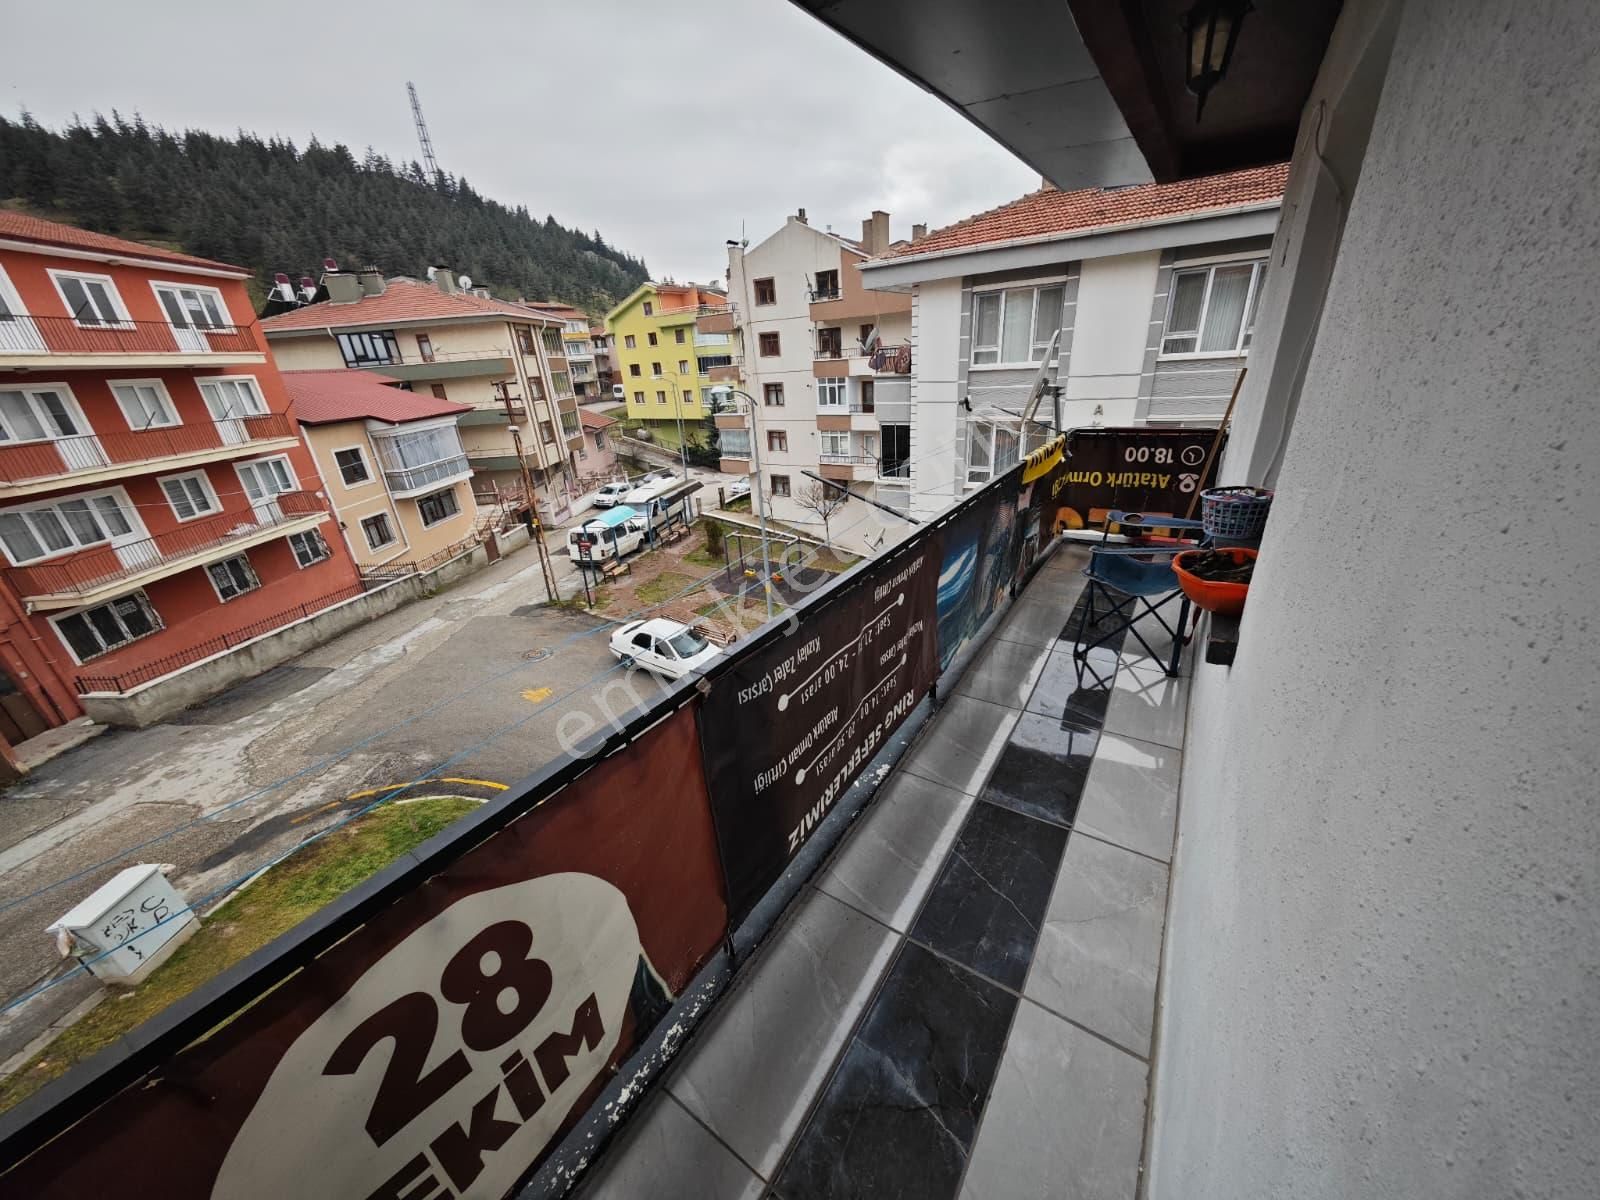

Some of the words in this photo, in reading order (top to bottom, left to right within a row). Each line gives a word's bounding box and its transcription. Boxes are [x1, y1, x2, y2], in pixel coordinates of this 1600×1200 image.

[1124, 447, 1174, 464] 18.00
[1107, 471, 1171, 488] Atatürk
[797, 636, 821, 665] Kızılay
[773, 656, 796, 683] Zafer
[825, 654, 848, 684] 24.00
[737, 672, 773, 705] Çarşısı
[801, 676, 822, 705] arası
[812, 706, 838, 740] Atatürk
[884, 689, 915, 729] RİNG
[788, 732, 813, 765] Orman
[816, 747, 836, 776] arası
[754, 757, 787, 795] Çiftliği
[788, 723, 883, 854] SEFERLERİMİZ
[321, 920, 553, 1148] 28
